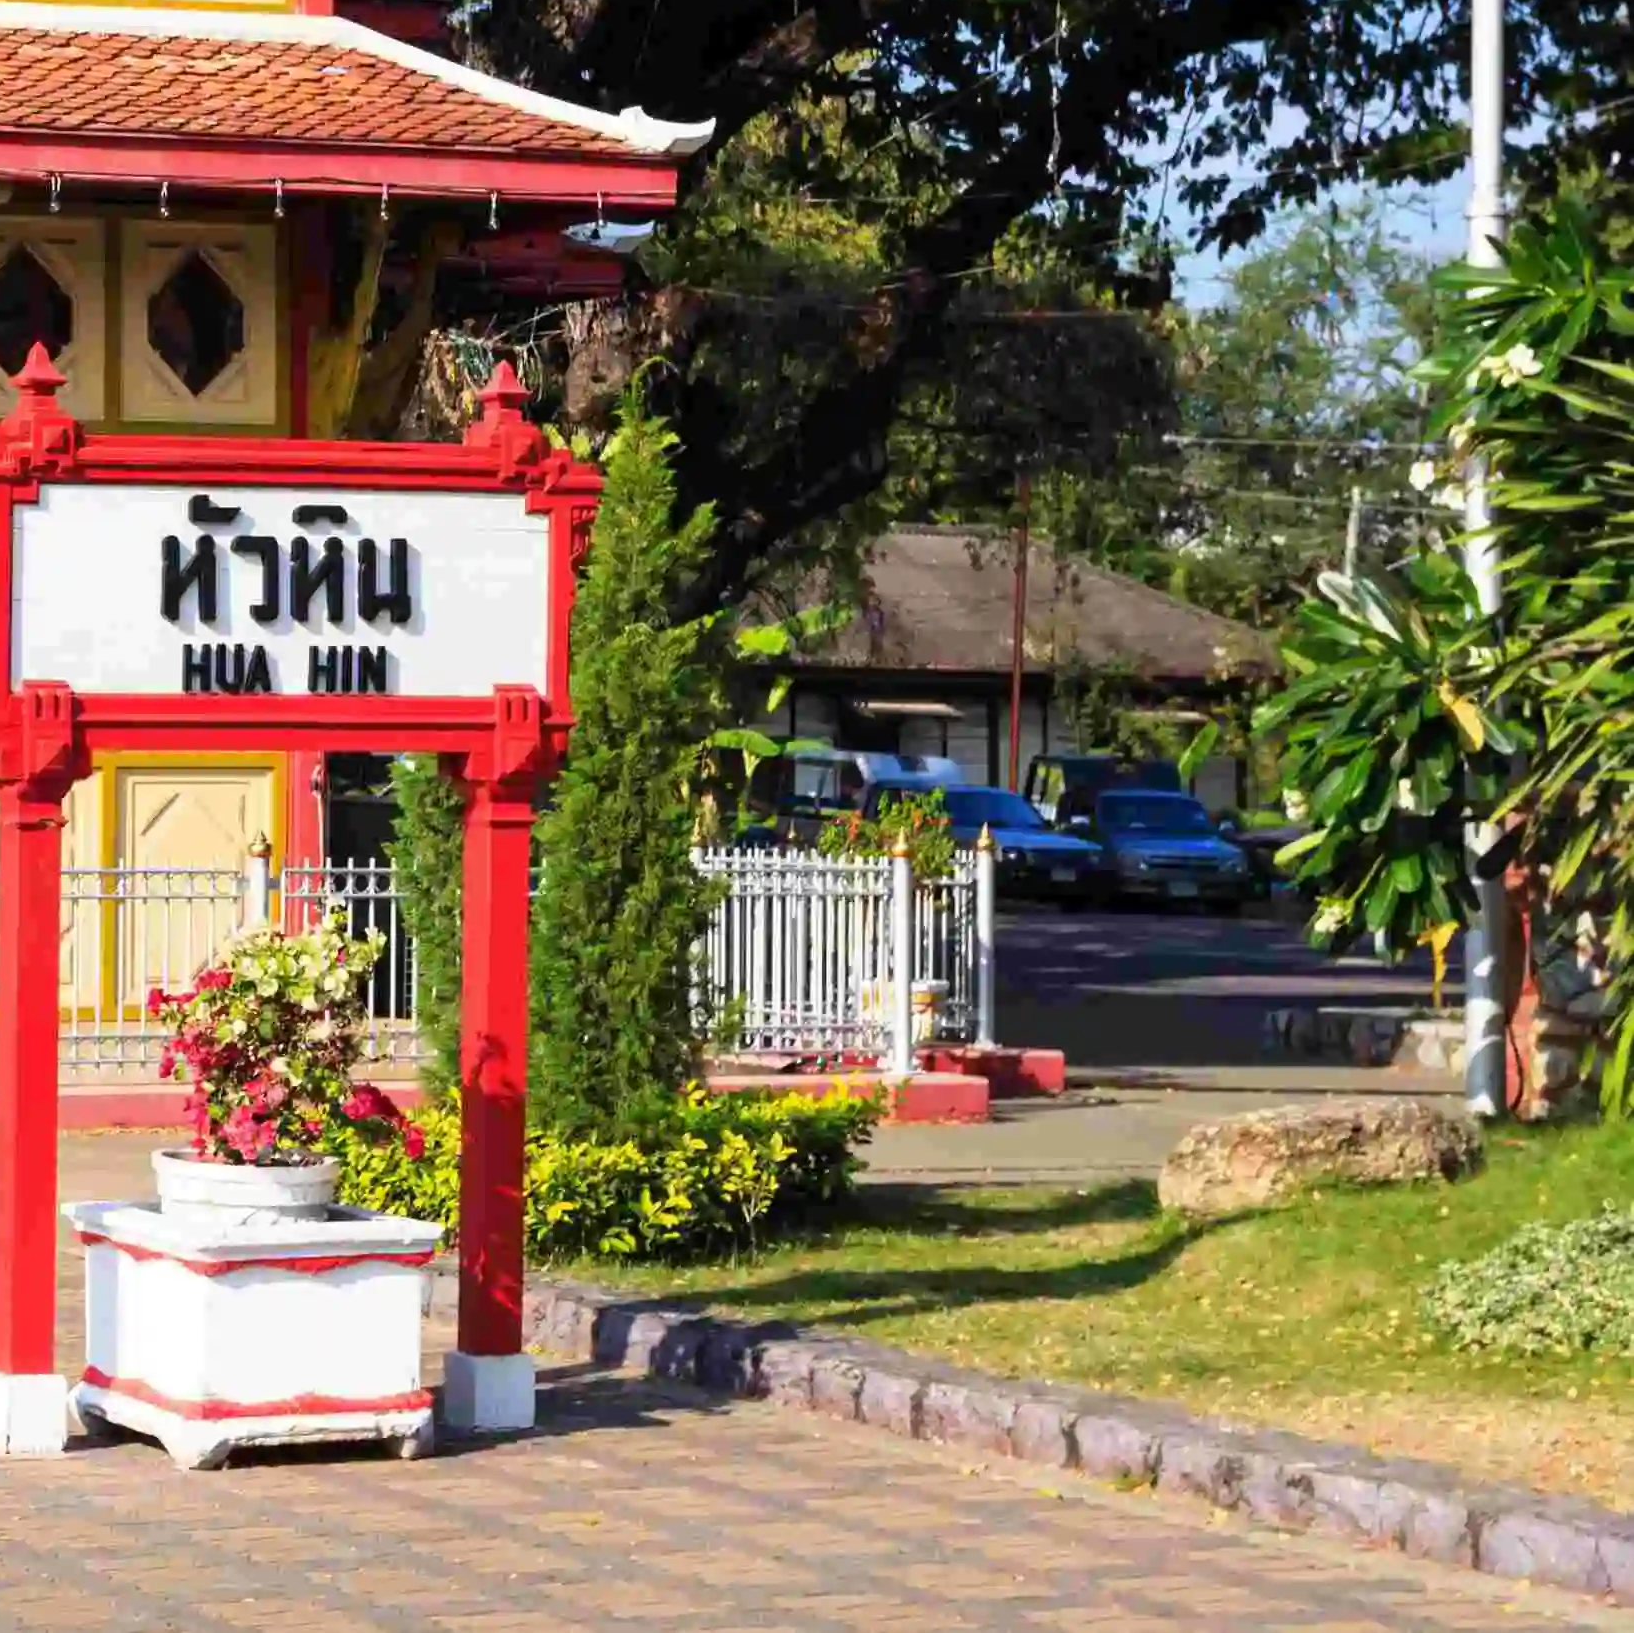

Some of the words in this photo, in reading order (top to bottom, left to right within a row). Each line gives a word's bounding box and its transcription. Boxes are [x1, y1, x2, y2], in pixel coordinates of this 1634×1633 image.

[160, 494, 412, 624] หัวหิน
[182, 643, 272, 693] HUA
[308, 645, 387, 694] HIN
